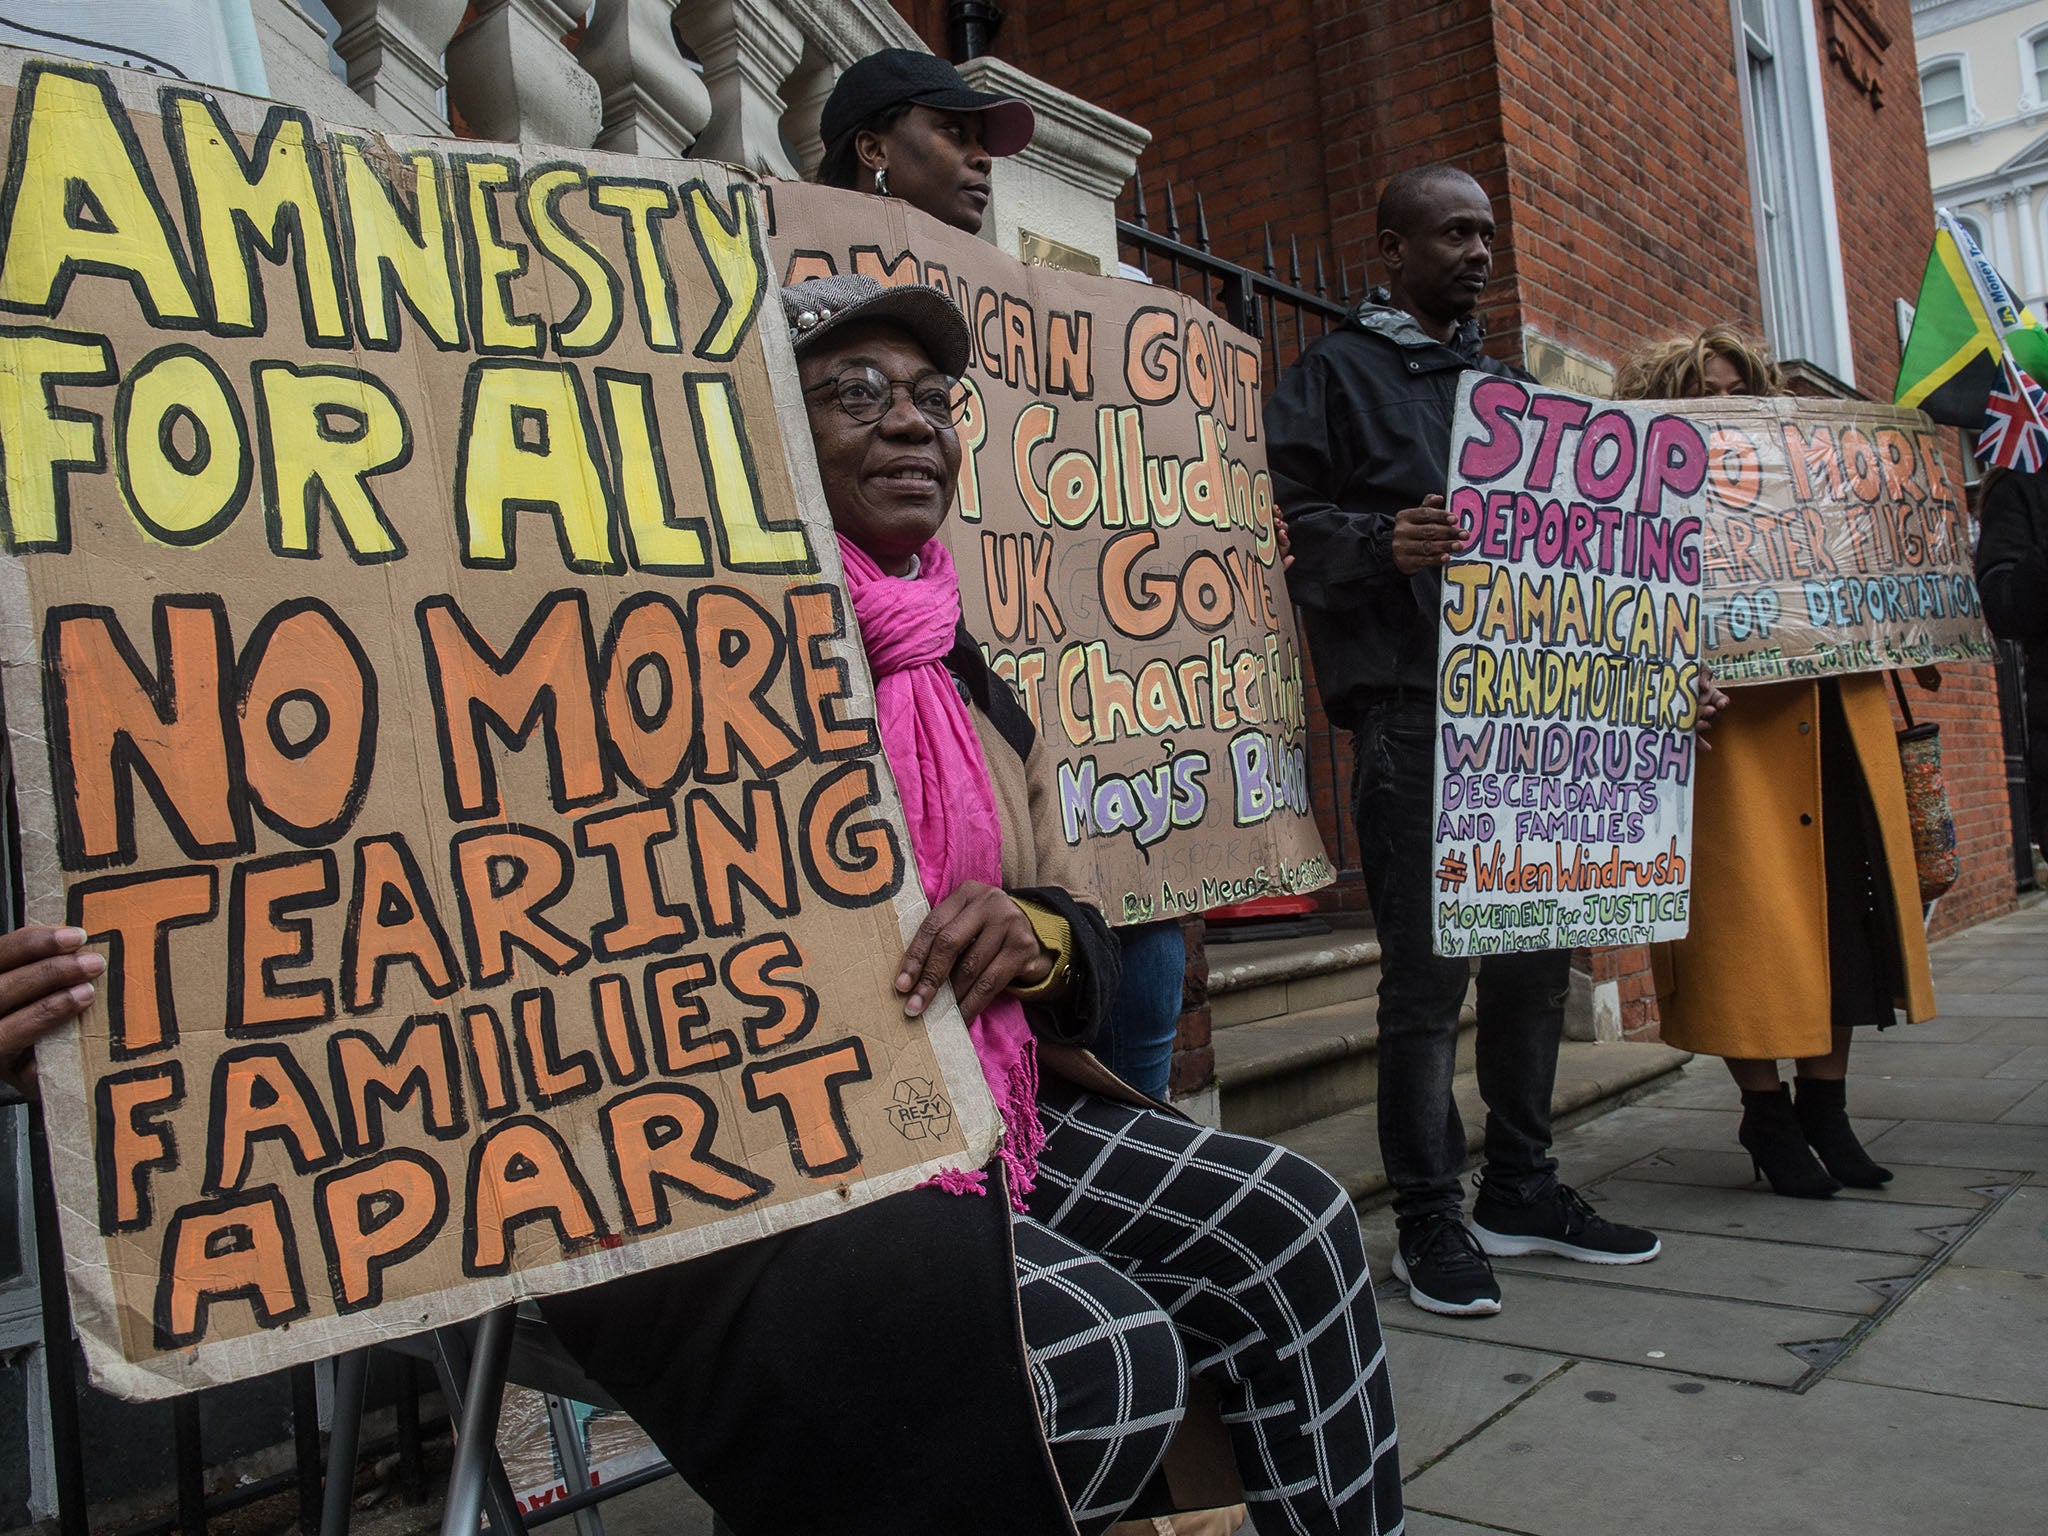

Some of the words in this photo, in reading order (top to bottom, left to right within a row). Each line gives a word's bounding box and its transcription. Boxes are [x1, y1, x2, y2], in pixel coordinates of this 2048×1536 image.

[0, 60, 770, 361] AMNESTY
[1978, 260, 2007, 304] Money
[0, 326, 414, 566] FOR
[456, 357, 823, 576] ALL
[1013, 401, 1276, 569] Colluding
[1458, 375, 1710, 518] STOP
[1780, 421, 1958, 504] MORE
[1449, 486, 1702, 586] DEPORTING
[1702, 505, 1839, 590] ARTER
[980, 530, 1067, 645] UK
[1443, 560, 1700, 660] JAMAICAN
[1701, 586, 1782, 650] TOP
[41, 593, 378, 871] NO
[417, 584, 881, 822] MORE
[1057, 636, 1268, 747] Charter
[1440, 644, 1700, 732] GRANDMOTHERS
[1441, 720, 1692, 785] WINDRUSH
[1442, 773, 1658, 815] DESCENDANTS
[1436, 811, 1495, 844] AND
[1515, 811, 1646, 844] FAMILIES
[68, 760, 906, 1062] TEARING
[1122, 891, 1154, 924] By
[1161, 877, 1199, 913] Any
[1441, 929, 1464, 956] By
[1468, 927, 1501, 954] Any
[1556, 923, 1655, 949] Necessary
[1584, 889, 1690, 926] JUSTICE
[94, 930, 820, 1237] FAMILIES
[898, 1100, 941, 1122] RESY
[154, 1035, 871, 1351] APART
